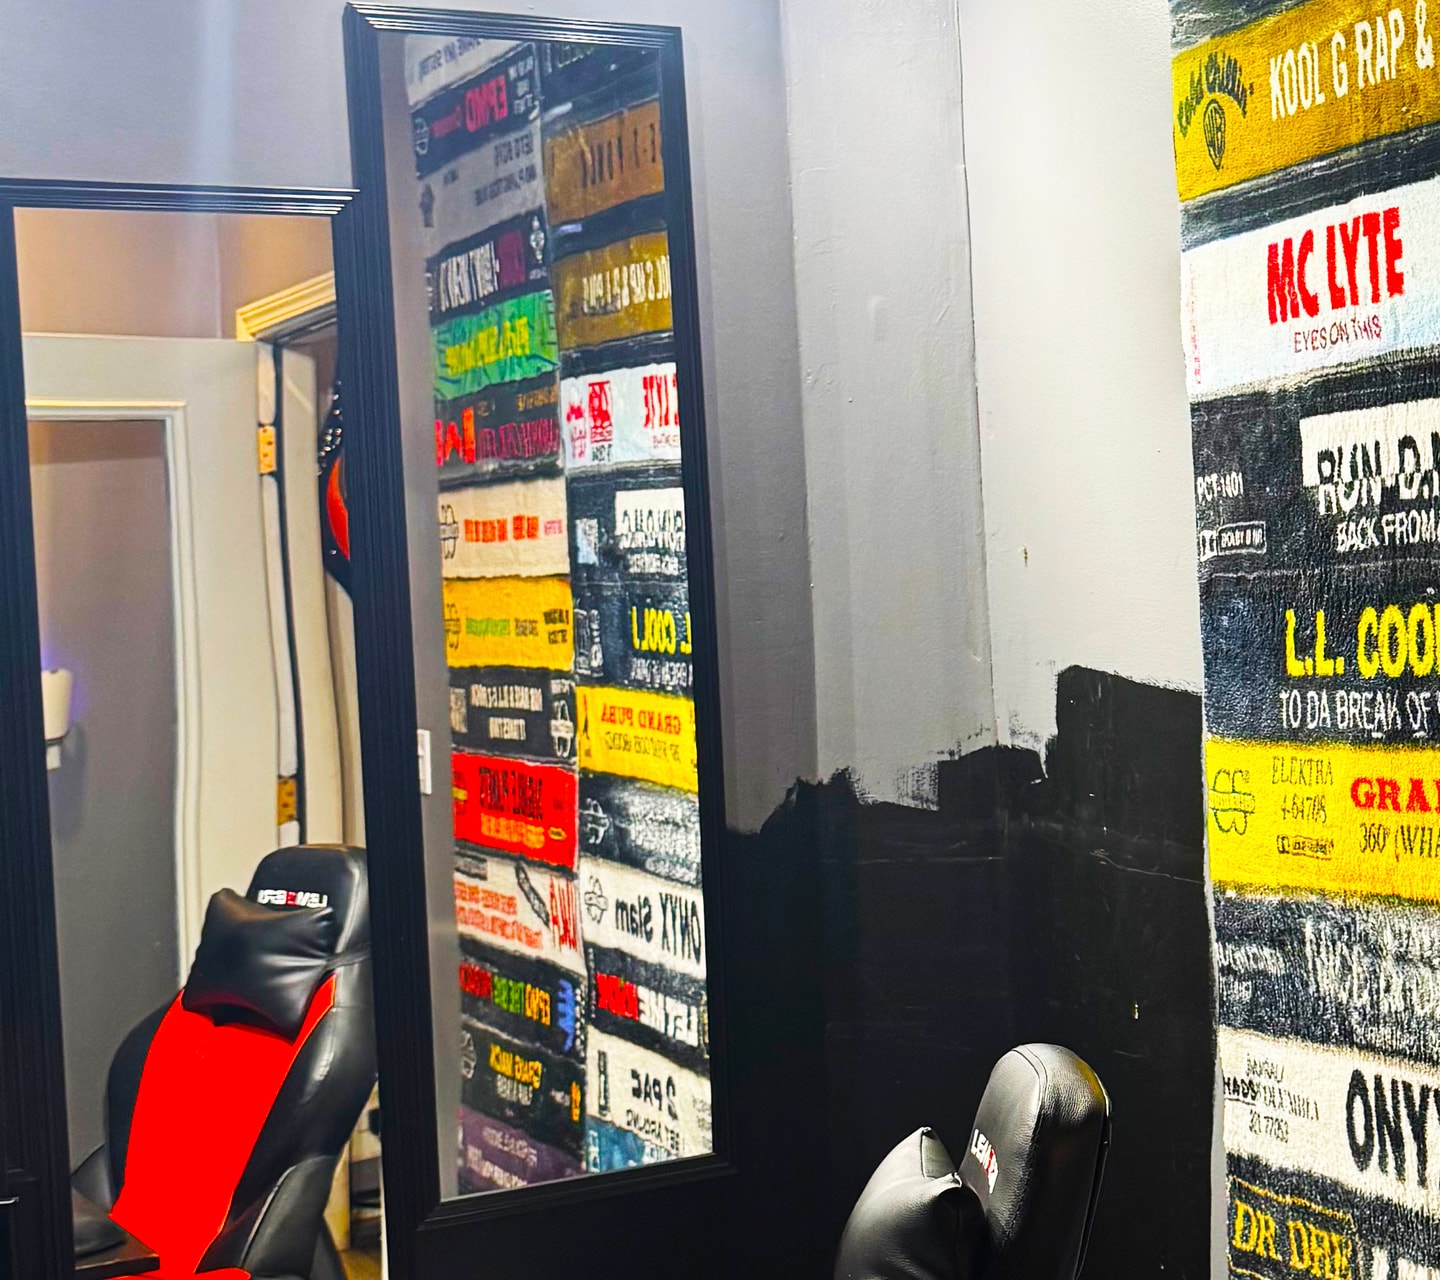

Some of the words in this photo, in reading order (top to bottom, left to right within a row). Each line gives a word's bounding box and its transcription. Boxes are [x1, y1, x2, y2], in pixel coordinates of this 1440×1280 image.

[1269, 42, 1326, 121] KOOL
[1332, 30, 1349, 96] G
[1355, 10, 1406, 89] RAP
[1266, 227, 1320, 326] MC
[1326, 206, 1406, 310] LYTE
[1293, 329, 1329, 354] EYES
[1352, 315, 1382, 346] THIS
[1335, 518, 1379, 554] BACK
[1382, 511, 1434, 548] FROM
[1284, 608, 1346, 679] L.L.
[1278, 689, 1302, 728] TO
[1306, 690, 1332, 728] DA
[1335, 689, 1401, 728] BREAK
[1406, 690, 1432, 730] OF
[1233, 1196, 1281, 1259] DR
